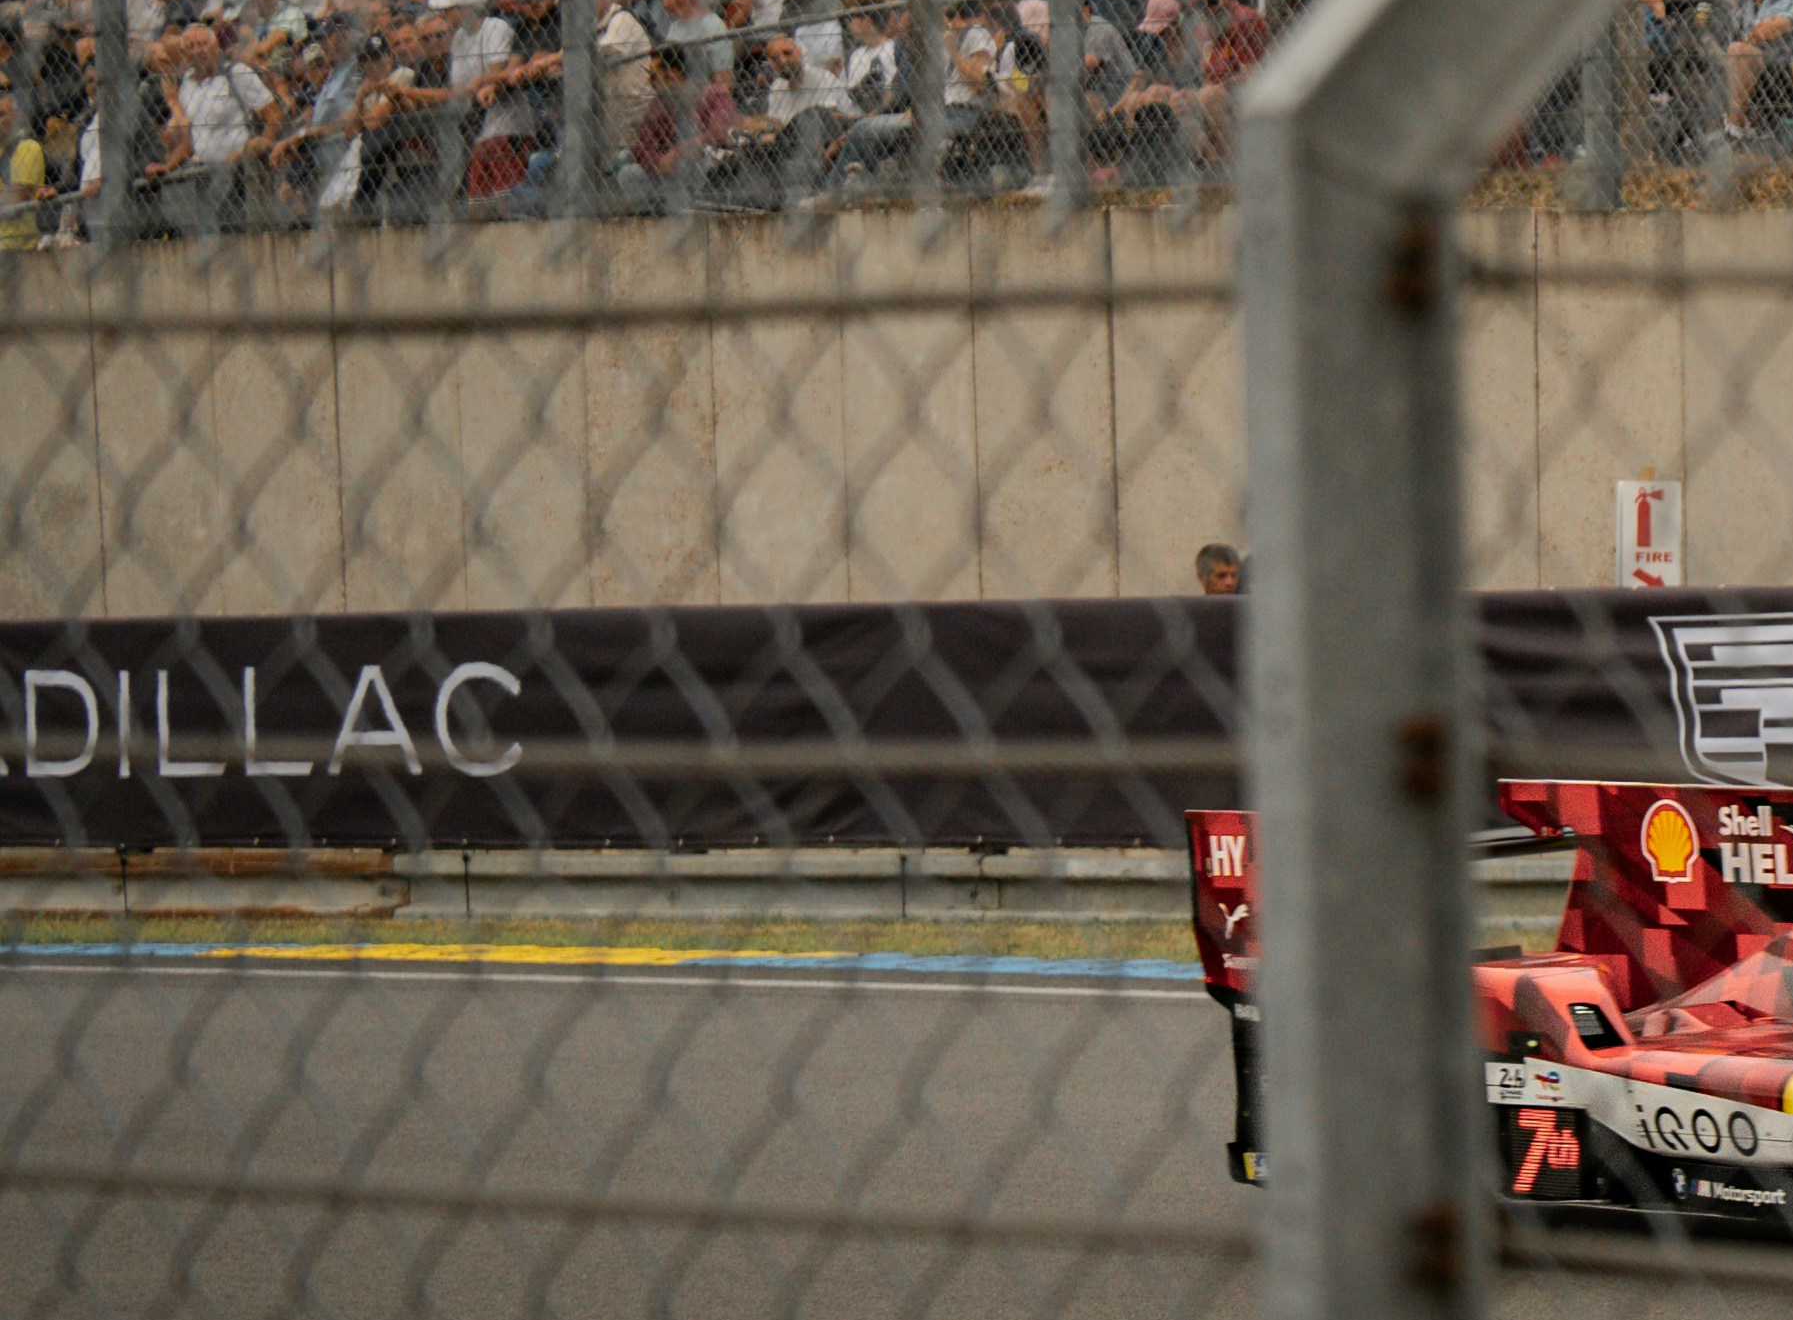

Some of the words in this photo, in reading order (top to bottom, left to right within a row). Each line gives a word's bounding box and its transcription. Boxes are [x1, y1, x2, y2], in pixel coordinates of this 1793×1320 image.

[1635, 551, 1674, 563] FIRE
[0, 662, 523, 778] DILLAC
[1718, 805, 1773, 837] Shell
[1209, 835, 1246, 877] HY
